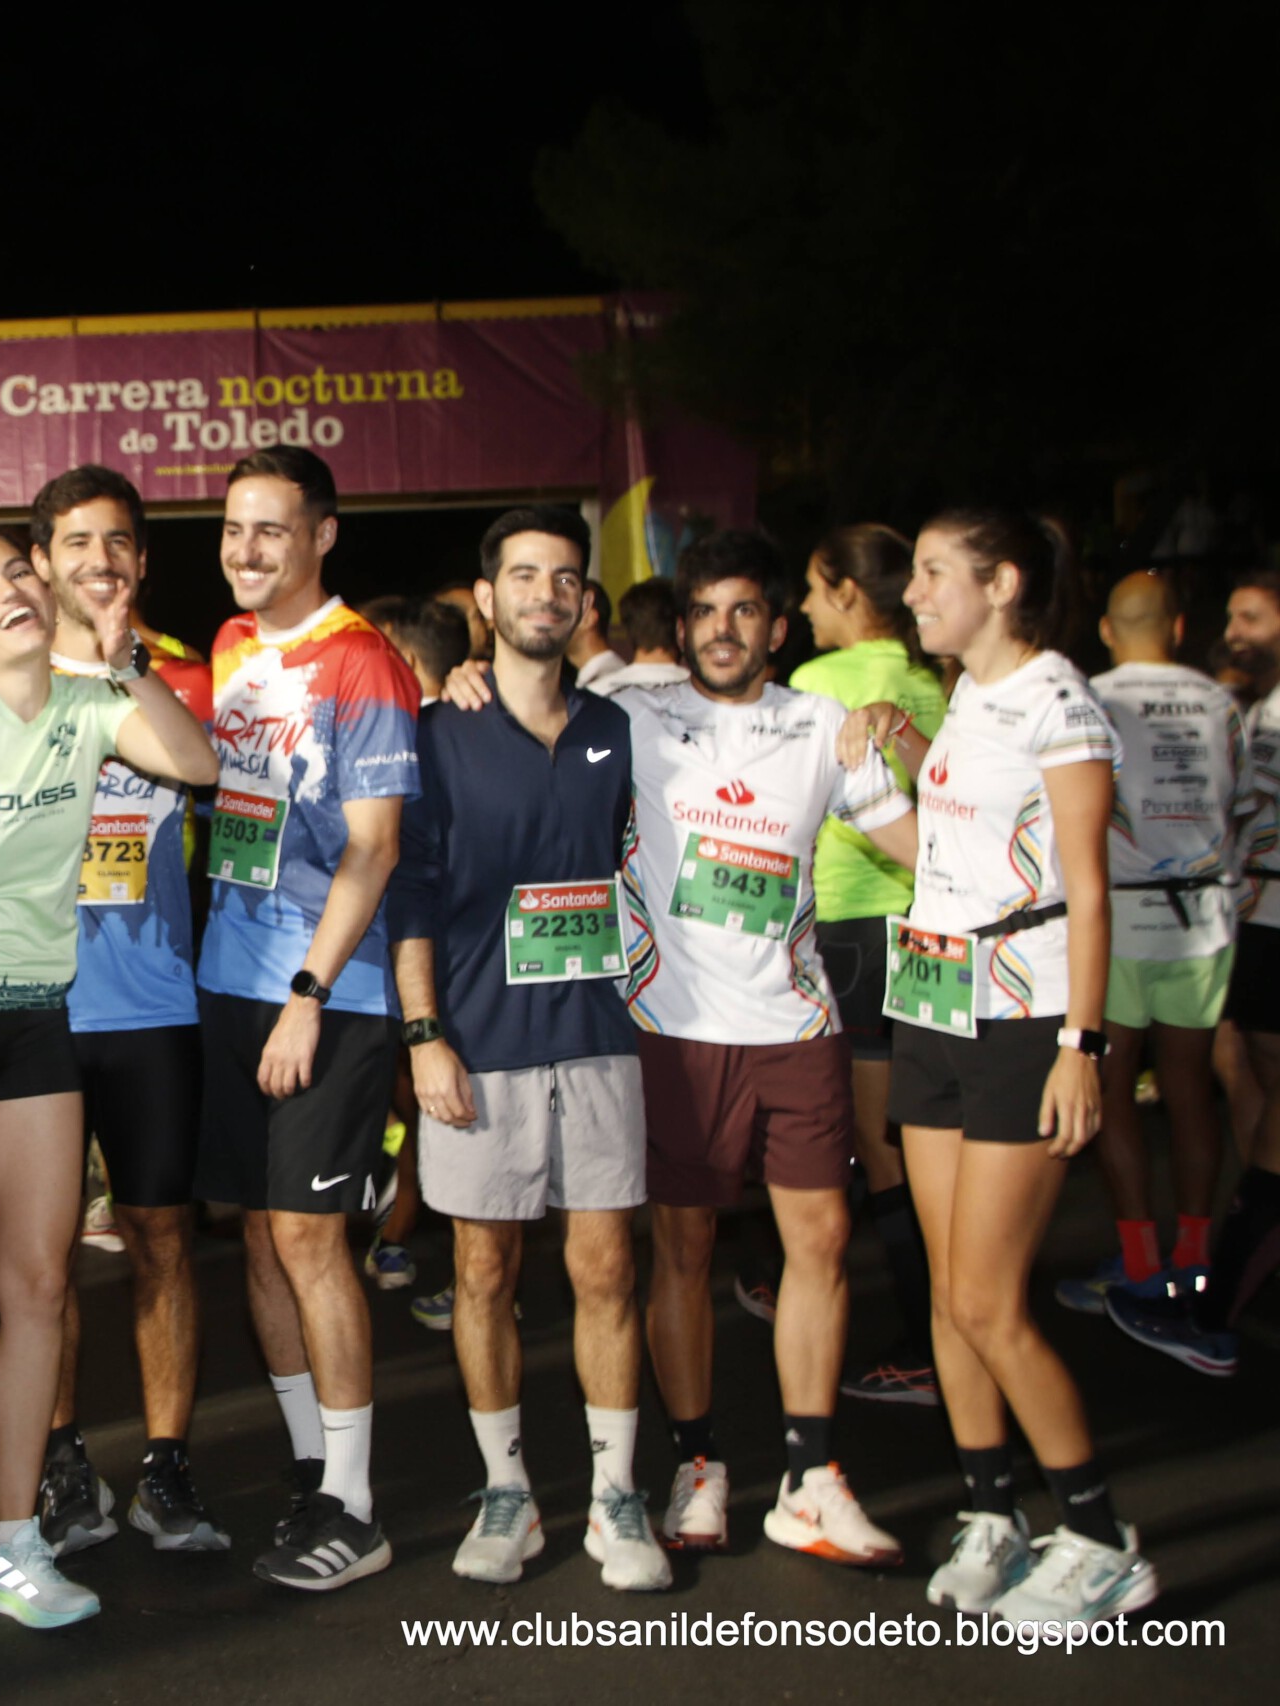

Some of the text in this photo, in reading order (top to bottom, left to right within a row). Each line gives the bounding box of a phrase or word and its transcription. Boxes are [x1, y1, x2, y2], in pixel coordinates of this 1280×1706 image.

[0, 365, 464, 416] Carrera nocturna
[120, 408, 344, 454] de Toledo
[223, 796, 276, 819] Santander
[673, 800, 791, 838] Santander
[213, 815, 259, 845] 1503
[720, 844, 791, 875] Santander
[712, 866, 767, 898] 943
[541, 889, 609, 909] Santander
[531, 912, 600, 938] 2233
